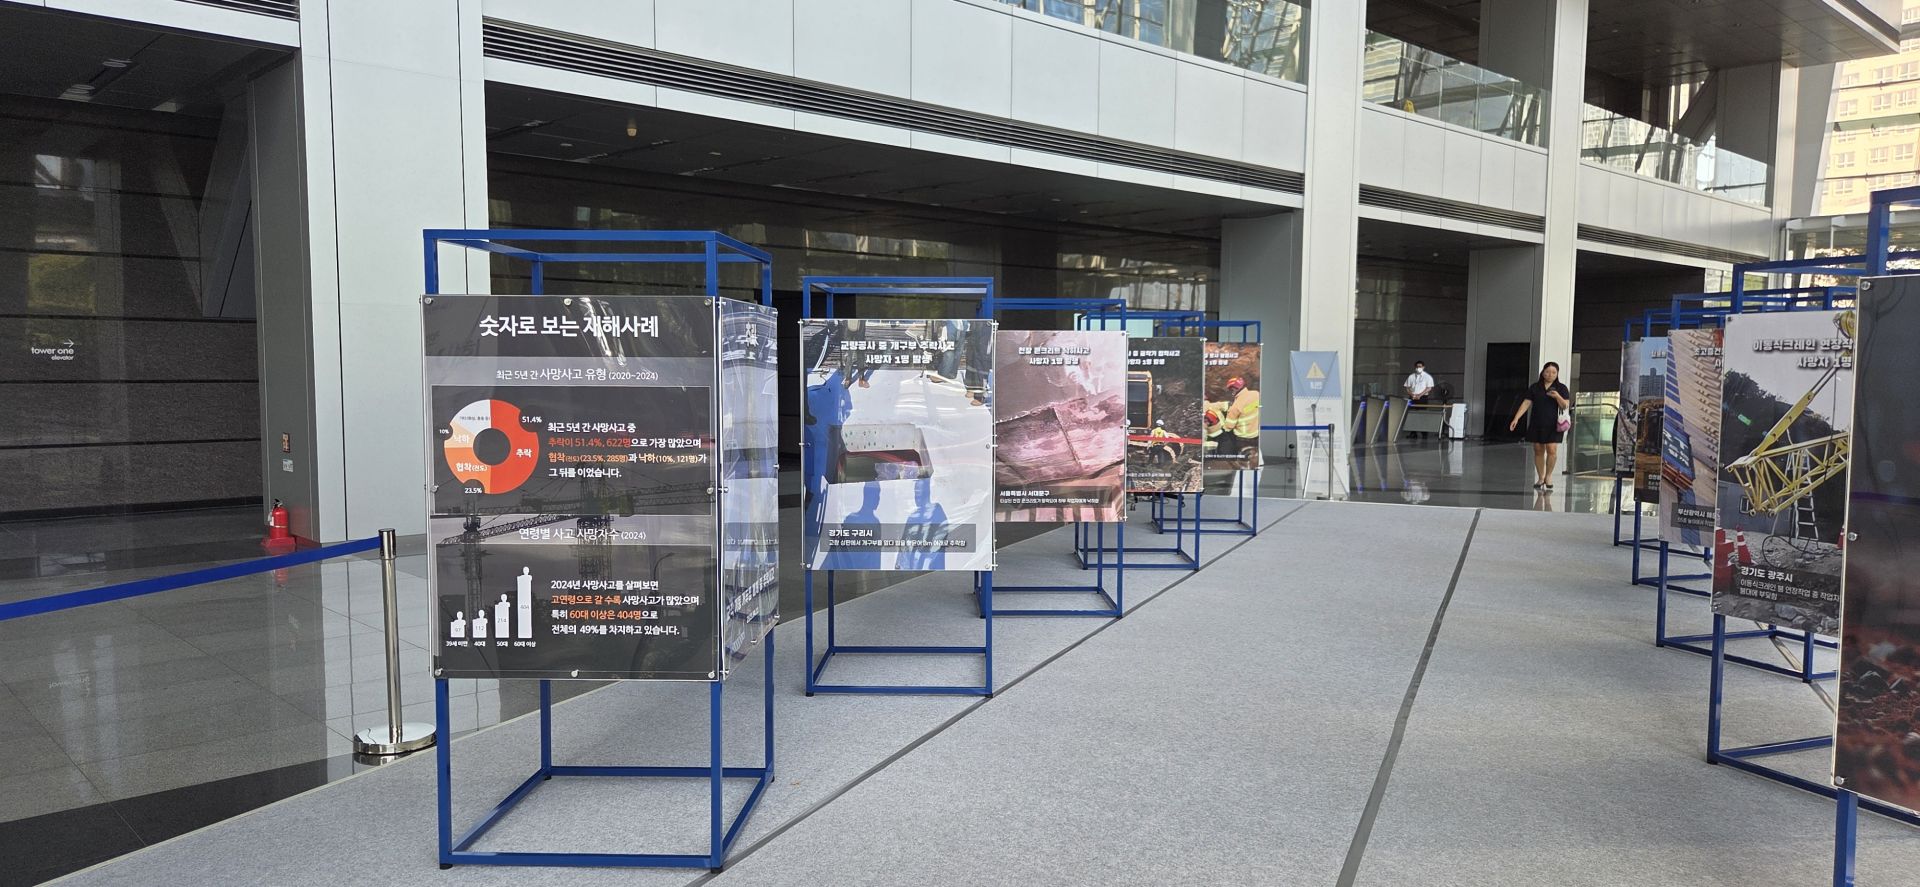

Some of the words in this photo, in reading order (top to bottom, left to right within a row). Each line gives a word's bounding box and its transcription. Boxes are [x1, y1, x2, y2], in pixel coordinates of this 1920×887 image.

[479, 315, 537, 337] 숫자로
[540, 315, 580, 336] 보는
[582, 315, 659, 338] 재해사례
[840, 340, 876, 350] 교량공사
[890, 340, 917, 350] 개구부
[920, 341, 955, 351] 추락사고
[1753, 339, 1816, 351] 이동식크레인
[1820, 339, 1854, 350] 연장작
[865, 354, 892, 364] 사망자
[894, 354, 910, 364] 1명
[1798, 356, 1829, 368] 사망자
[1832, 356, 1852, 368] 1명
[496, 370, 514, 380] 최근
[514, 370, 528, 380] 5년
[529, 370, 538, 380] 간
[540, 368, 583, 381] 사망사고
[585, 368, 607, 381] 유형
[608, 370, 658, 380] (2020~2024)
[548, 423, 565, 432] 최근
[566, 423, 580, 432] 5년
[582, 423, 591, 432] 간
[592, 423, 626, 432] 사망사고
[627, 423, 636, 433] 중
[548, 438, 573, 448] 추락이
[575, 438, 605, 448] 51.4%,
[606, 438, 648, 448] 622명으로
[649, 438, 667, 448] 가장
[667, 438, 702, 448] 많았으며
[516, 448, 532, 458] 추락
[606, 454, 638, 463] 285명)과
[638, 454, 676, 463] 낙하(10%,
[676, 454, 707, 464] 121명)가
[548, 468, 558, 477] 그
[559, 468, 576, 478] 뒤를
[578, 468, 622, 478] 이었습니다.
[518, 528, 550, 540] 연령별
[553, 528, 575, 540] 사고
[576, 528, 619, 540] 사망자수
[620, 531, 646, 540] (2024)
[828, 529, 850, 537] 경기도
[1741, 566, 1766, 578] 경기도
[1767, 570, 1793, 583] 광주시
[550, 580, 580, 590] 2024년
[582, 580, 624, 590] 사망사고를
[625, 580, 659, 590] 살펴보면
[1740, 579, 1777, 592] 이동식크레인
[1785, 586, 1811, 598] 연장작업
[550, 595, 593, 605] 고연령으로
[594, 595, 603, 605] 갈
[604, 596, 621, 605] 수록
[622, 596, 664, 605] 사망사고가
[666, 596, 700, 606] 많았으며
[550, 610, 568, 619] 특히
[569, 610, 589, 620] 60대
[590, 610, 616, 620] 이상은
[616, 610, 658, 620] 404명으로
[551, 624, 577, 635] 전체의
[579, 624, 608, 635] 49%를
[608, 625, 643, 635] 차지하고
[644, 625, 680, 635] 있습니다.
